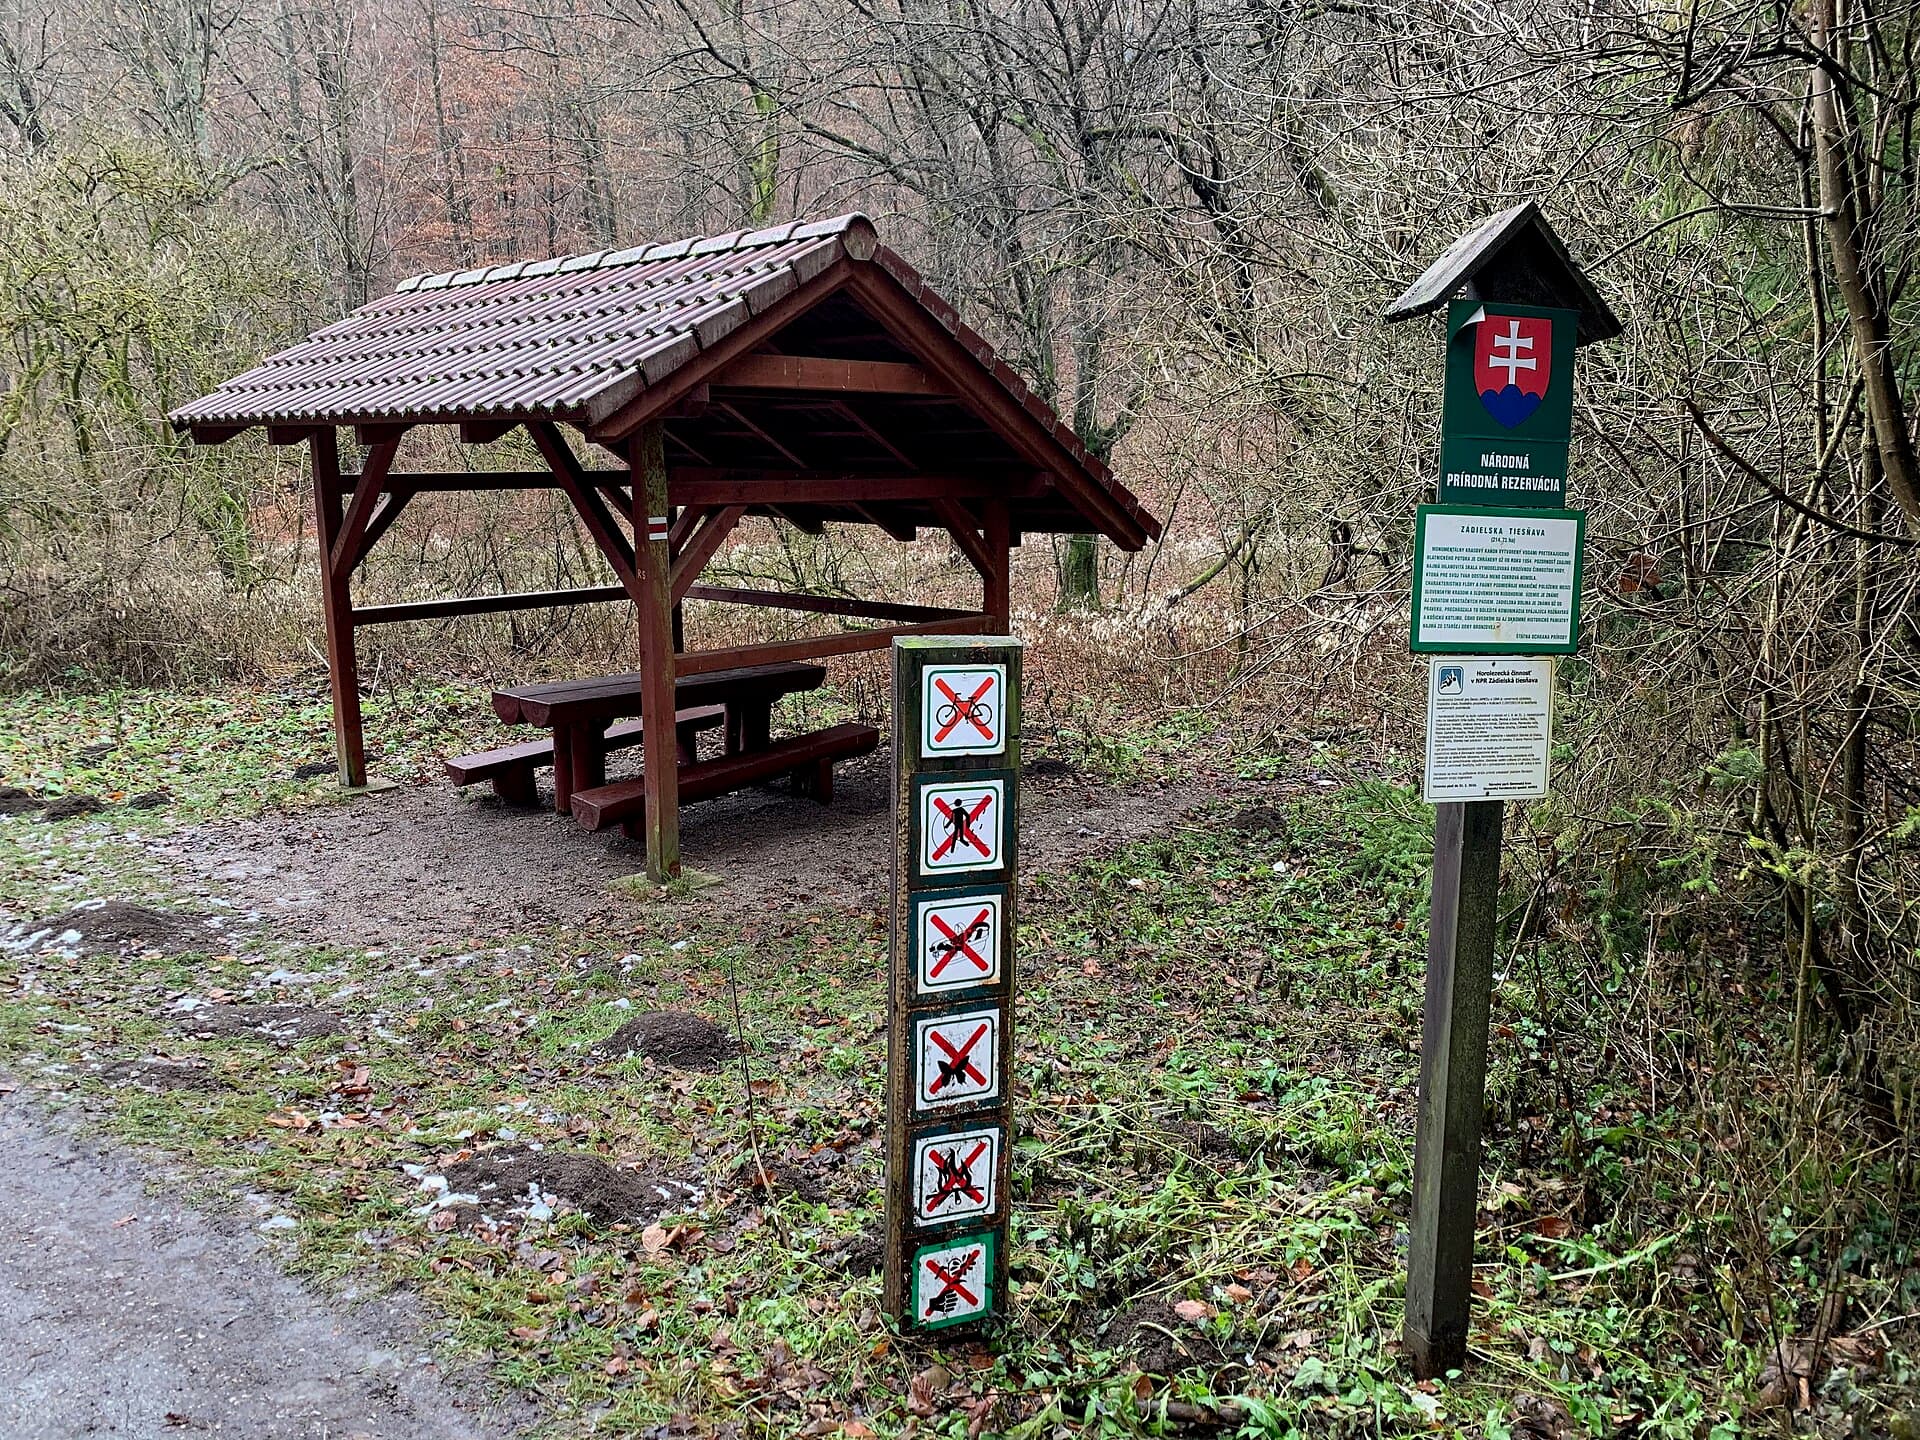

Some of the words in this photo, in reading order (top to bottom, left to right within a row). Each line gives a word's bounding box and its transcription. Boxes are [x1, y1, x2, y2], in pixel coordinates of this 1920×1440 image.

[1480, 451, 1530, 470] NÁRODNÁ
[1446, 471, 1499, 489] PRÍRODNÁ
[1501, 475, 1560, 492] REZERVÁCIA
[1509, 527, 1545, 536] TIESŇAVA
